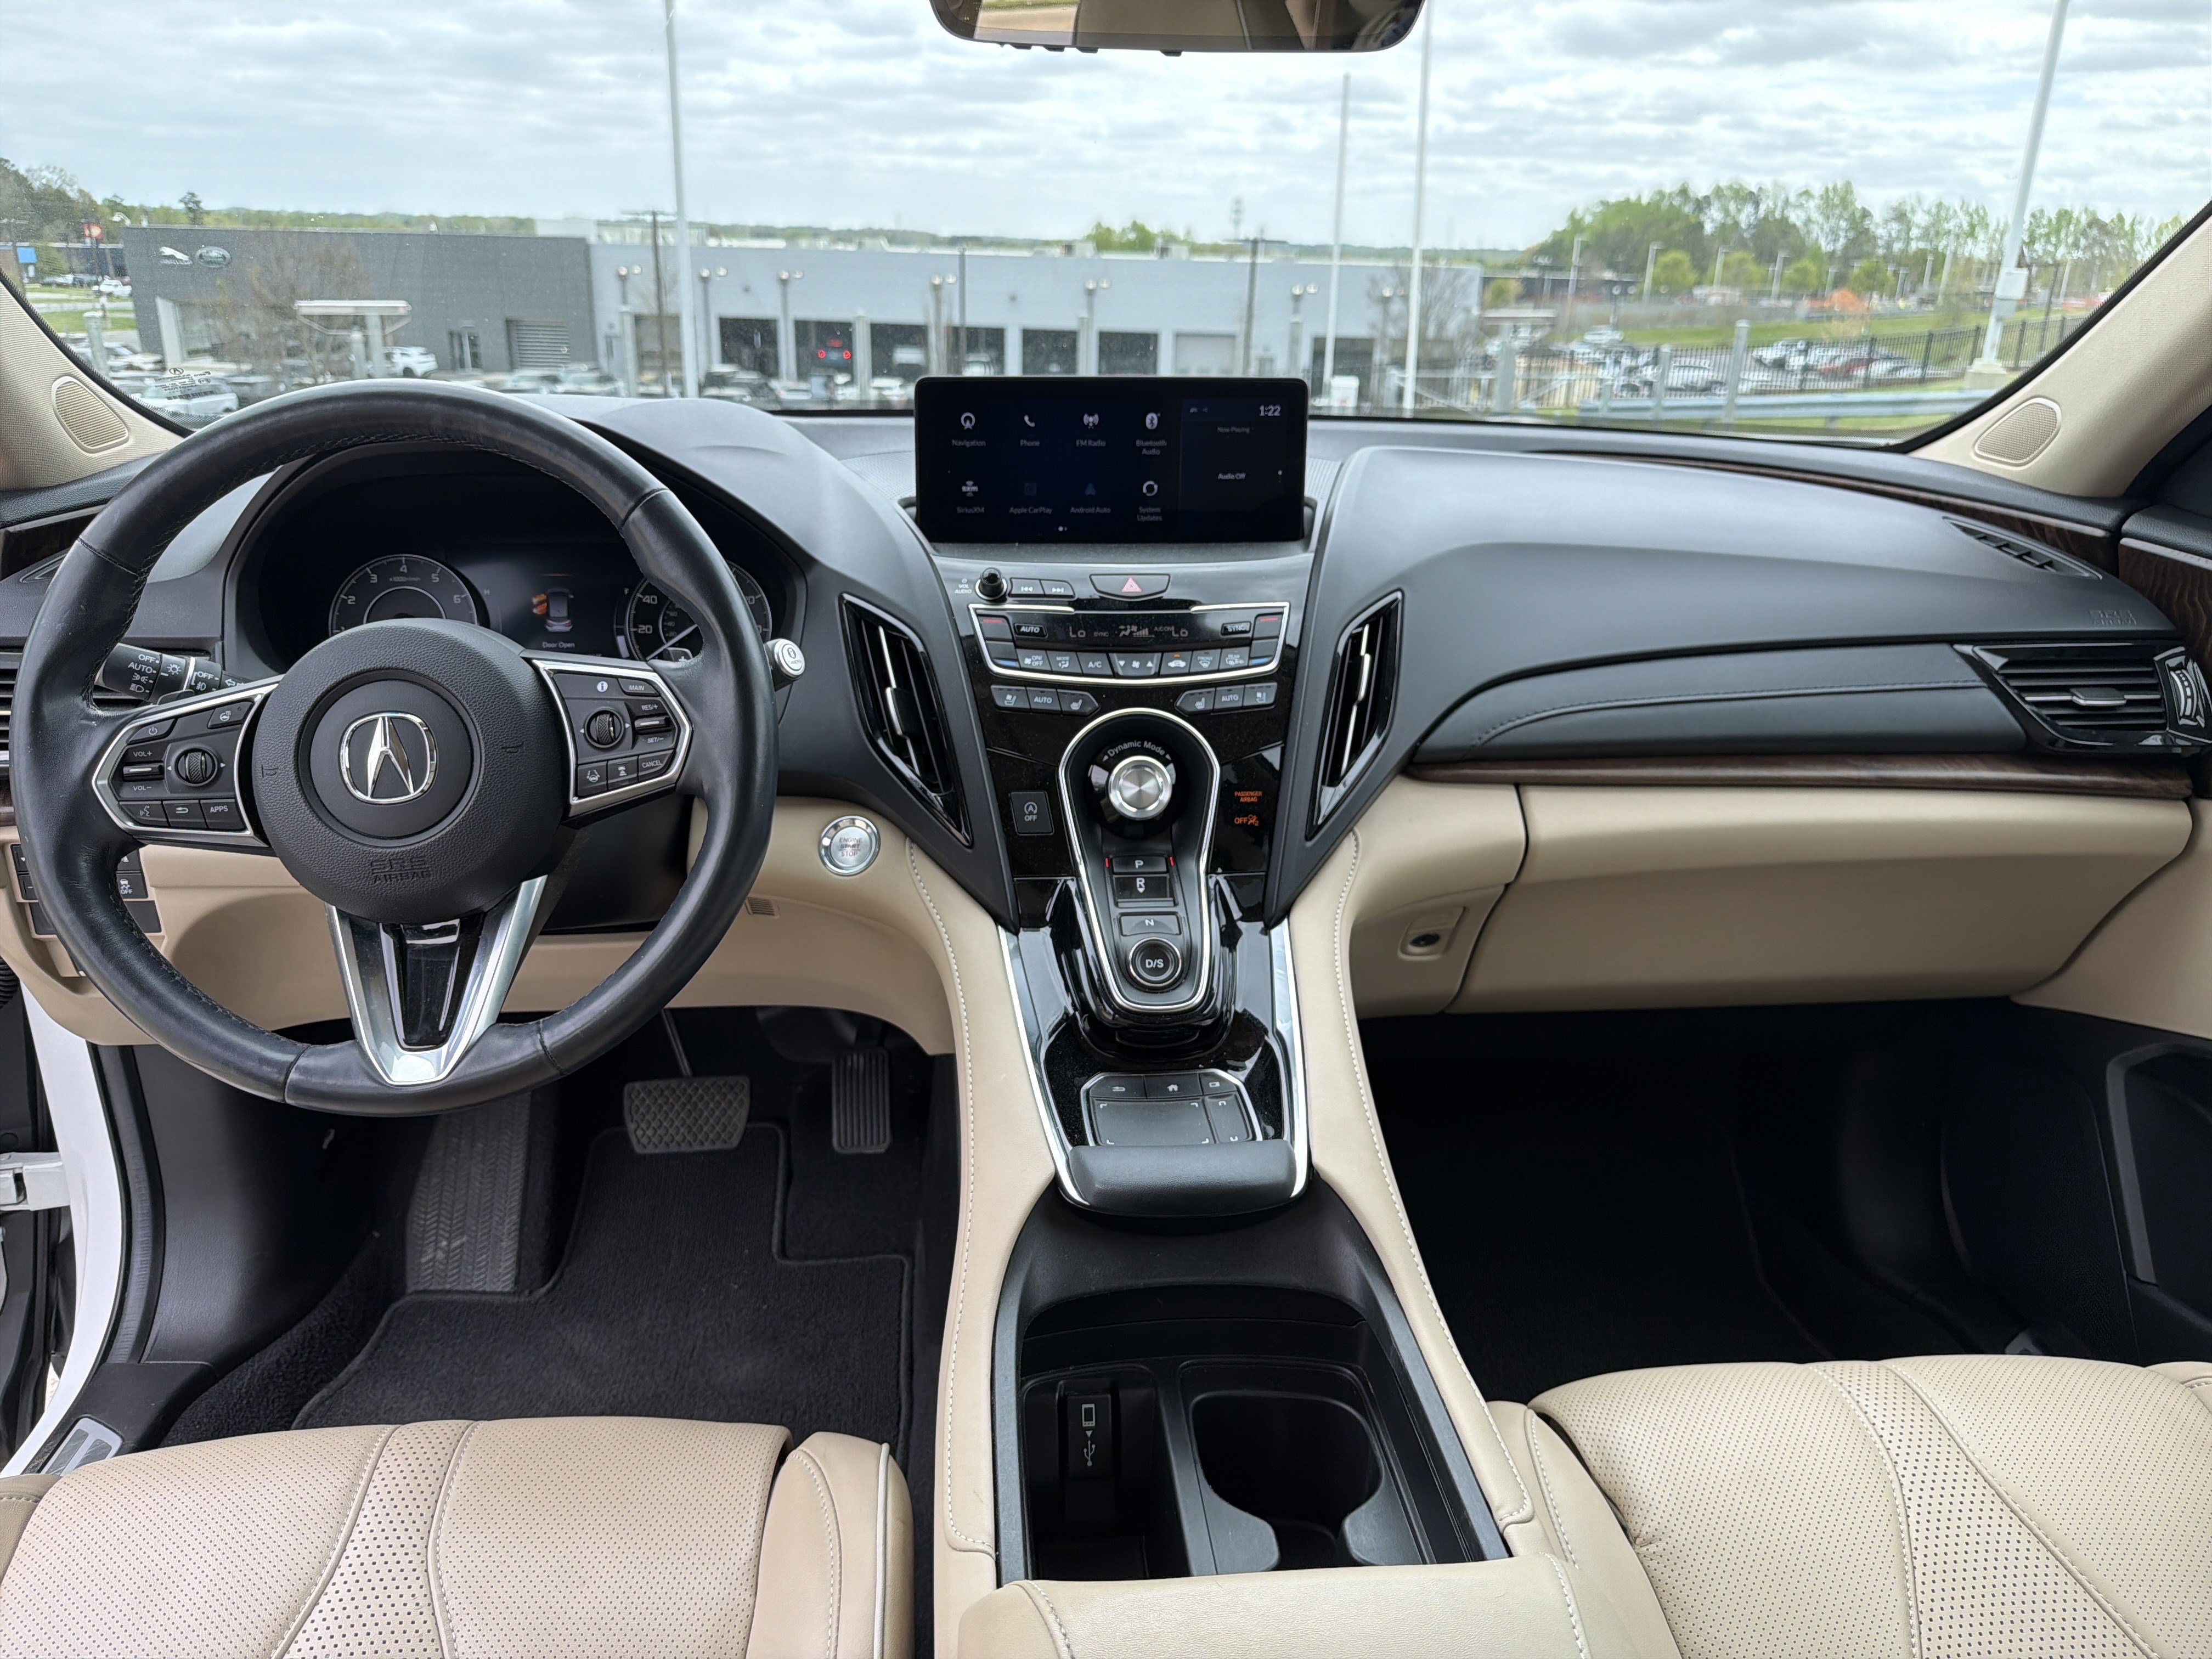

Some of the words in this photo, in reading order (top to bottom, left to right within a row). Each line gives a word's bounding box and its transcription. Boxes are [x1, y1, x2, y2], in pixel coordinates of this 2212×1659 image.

[1259, 405, 1281, 416] 1:22
[1029, 506, 1052, 515] CarPlay
[370, 574, 378, 583] 3
[431, 573, 439, 583] 5
[347, 596, 356, 605] 2
[453, 595, 461, 603] 6
[642, 595, 658, 605] 40
[637, 624, 653, 634] 20
[1227, 623, 1246, 632] SYNC
[138, 653, 156, 663] OFF
[128, 662, 153, 673] AUTO
[196, 671, 213, 680] OFF
[1034, 696, 1052, 704] AUTO
[1222, 694, 1239, 702] AUTO
[1107, 740, 1142, 757] Dynamic
[1143, 740, 1165, 756] Mode
[210, 805, 228, 814] APPS
[1135, 860, 1144, 868] P
[1136, 878, 1145, 888] R
[1146, 958, 1164, 968] D/S
